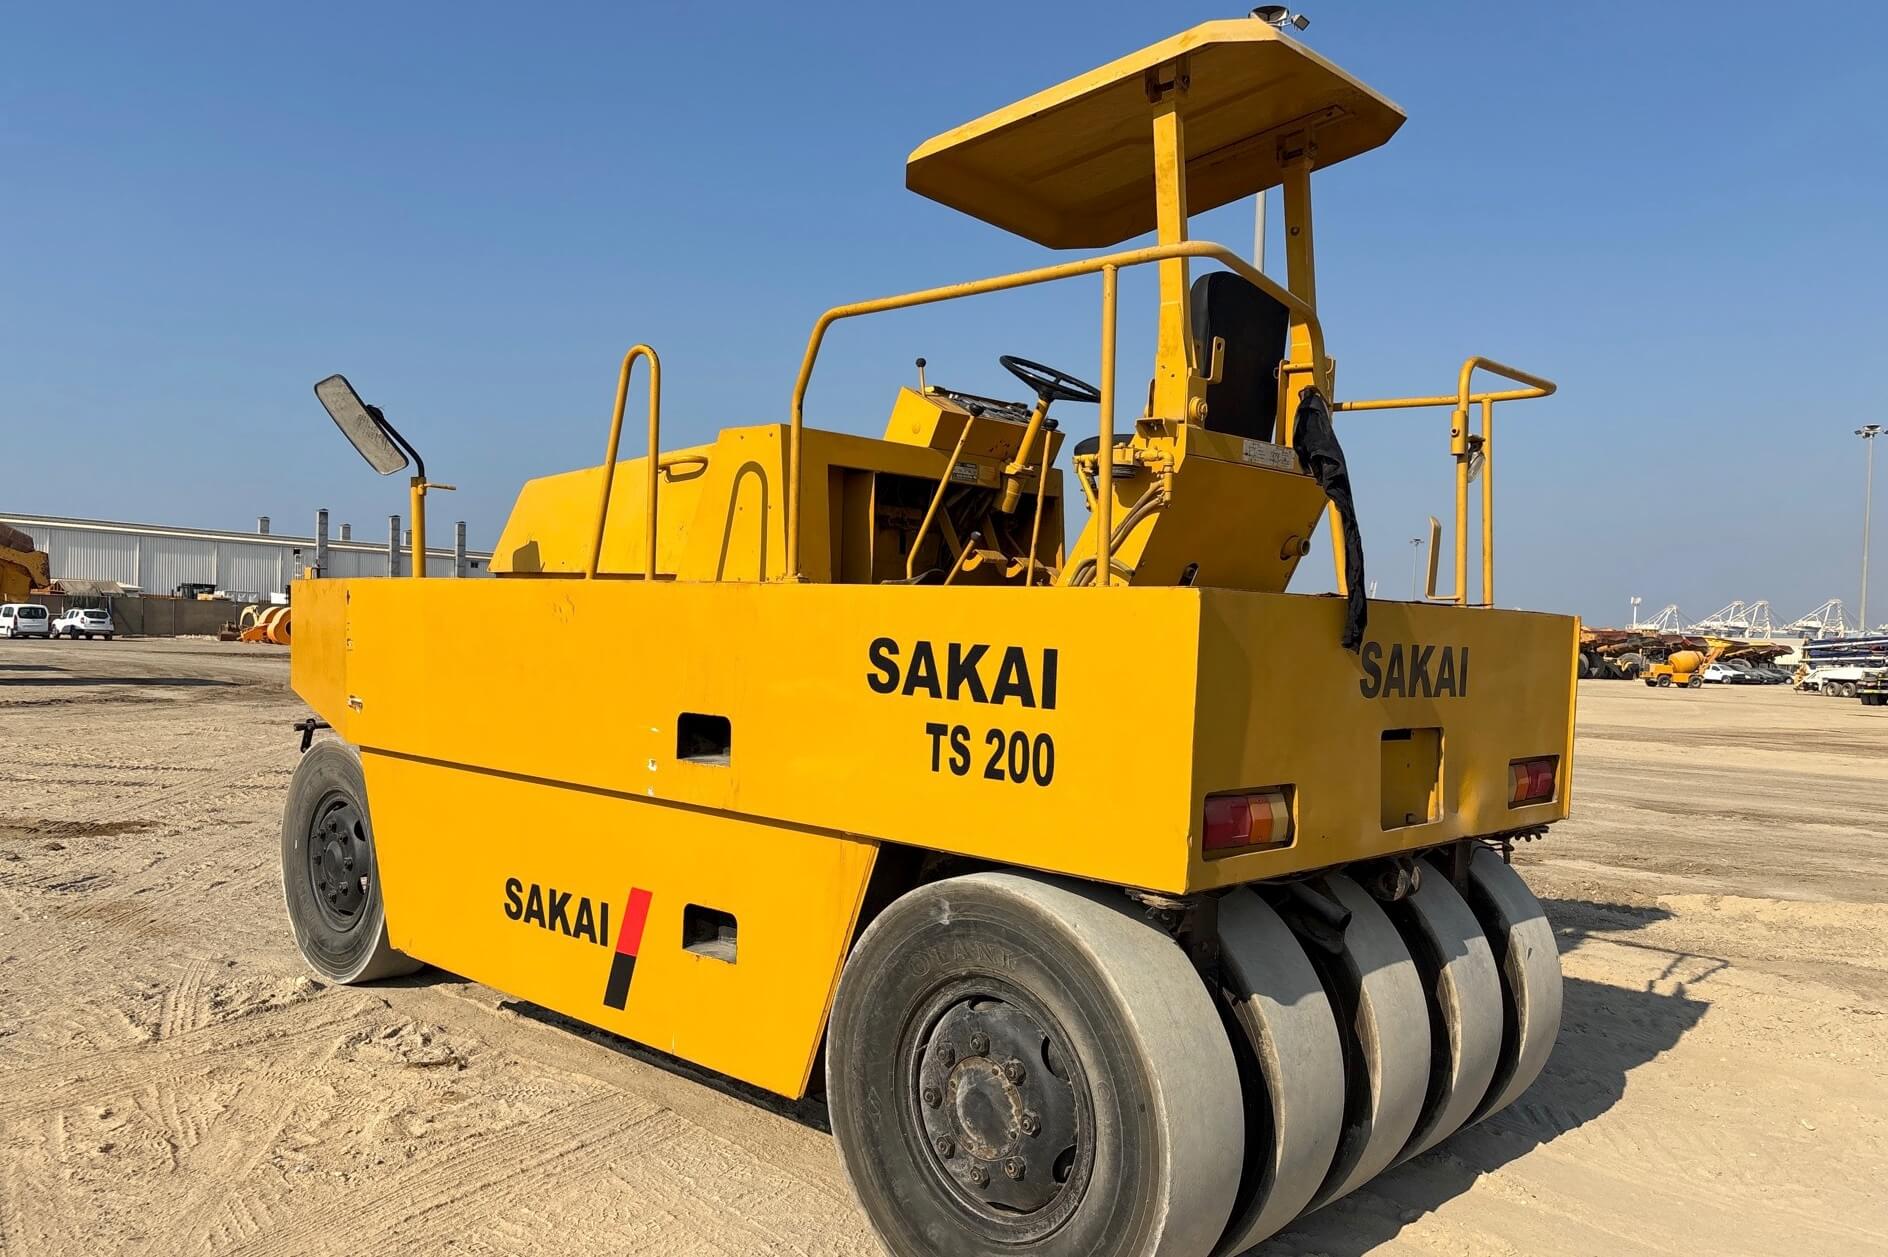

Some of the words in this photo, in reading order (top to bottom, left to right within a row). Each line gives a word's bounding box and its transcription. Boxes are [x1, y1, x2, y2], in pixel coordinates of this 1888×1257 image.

[867, 637, 1058, 710] SAKAI
[1360, 641, 1469, 698] SAKAI
[926, 722, 971, 776] TS
[984, 728, 1055, 787] 200
[503, 877, 609, 947] SAKAI
